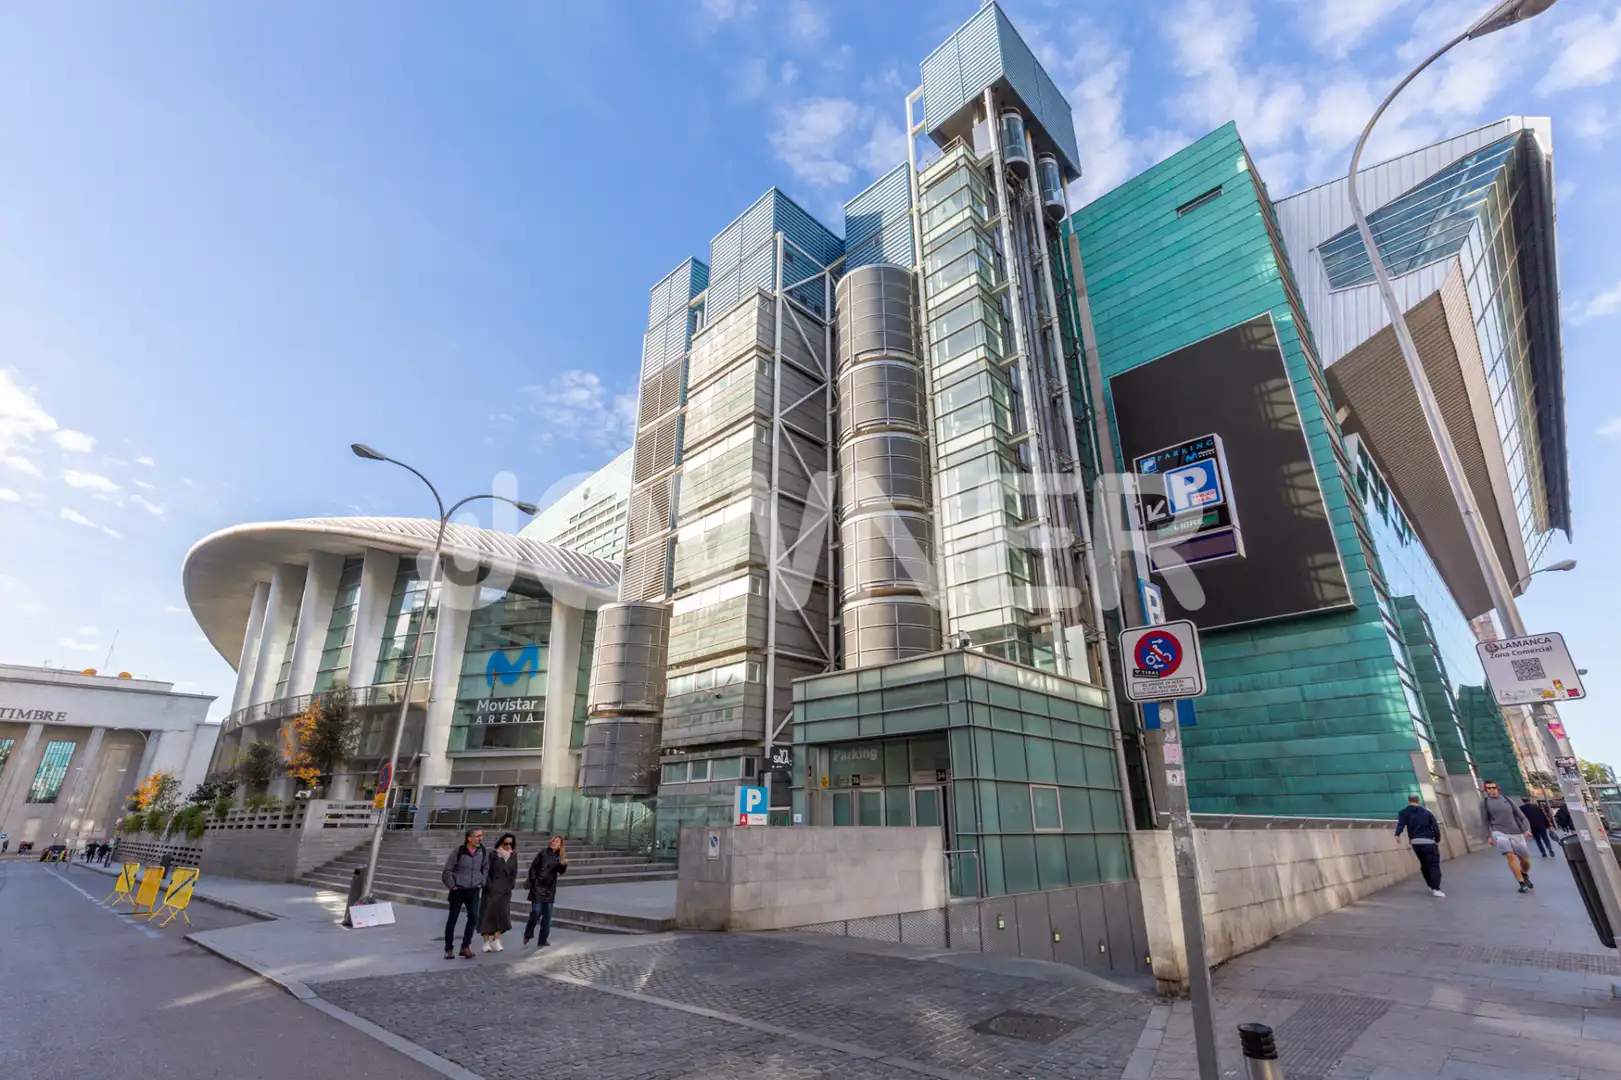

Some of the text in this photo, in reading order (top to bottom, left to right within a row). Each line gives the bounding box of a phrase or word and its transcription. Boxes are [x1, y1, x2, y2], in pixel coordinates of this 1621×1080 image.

[1157, 439, 1214, 462] PARKING
[1171, 467, 1207, 510] P
[1173, 517, 1205, 531] LIBRE
[1512, 645, 1553, 656] Comercial
[476, 698, 538, 712] Movistar
[0, 707, 68, 722] TIMBRE
[475, 713, 534, 724] ARENA
[833, 747, 878, 761] Parking
[746, 788, 762, 813] P
